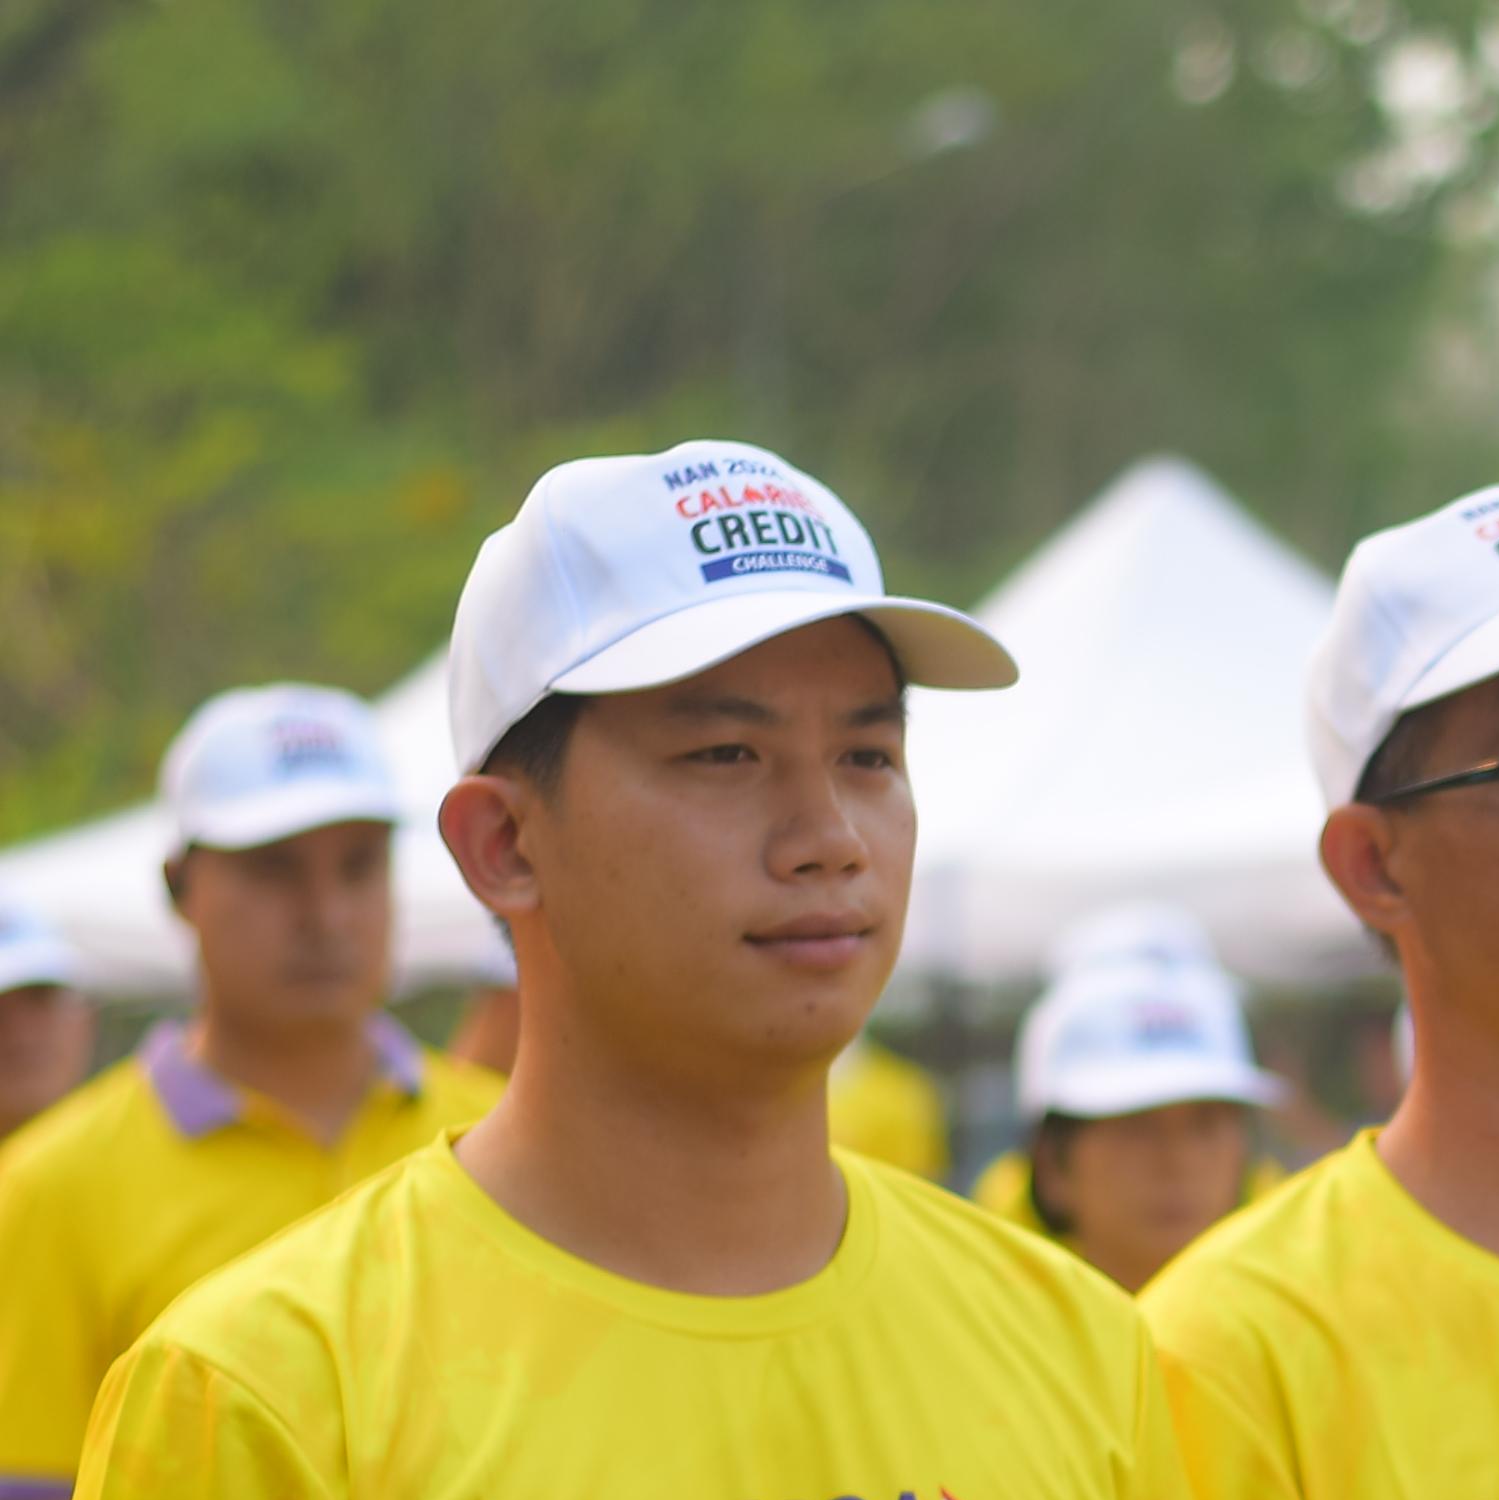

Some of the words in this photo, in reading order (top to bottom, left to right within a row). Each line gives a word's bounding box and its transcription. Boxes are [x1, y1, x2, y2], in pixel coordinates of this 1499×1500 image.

[664, 461, 720, 491] NAN
[690, 510, 839, 555] CREDIT
[732, 553, 829, 573] CHALLENGE
